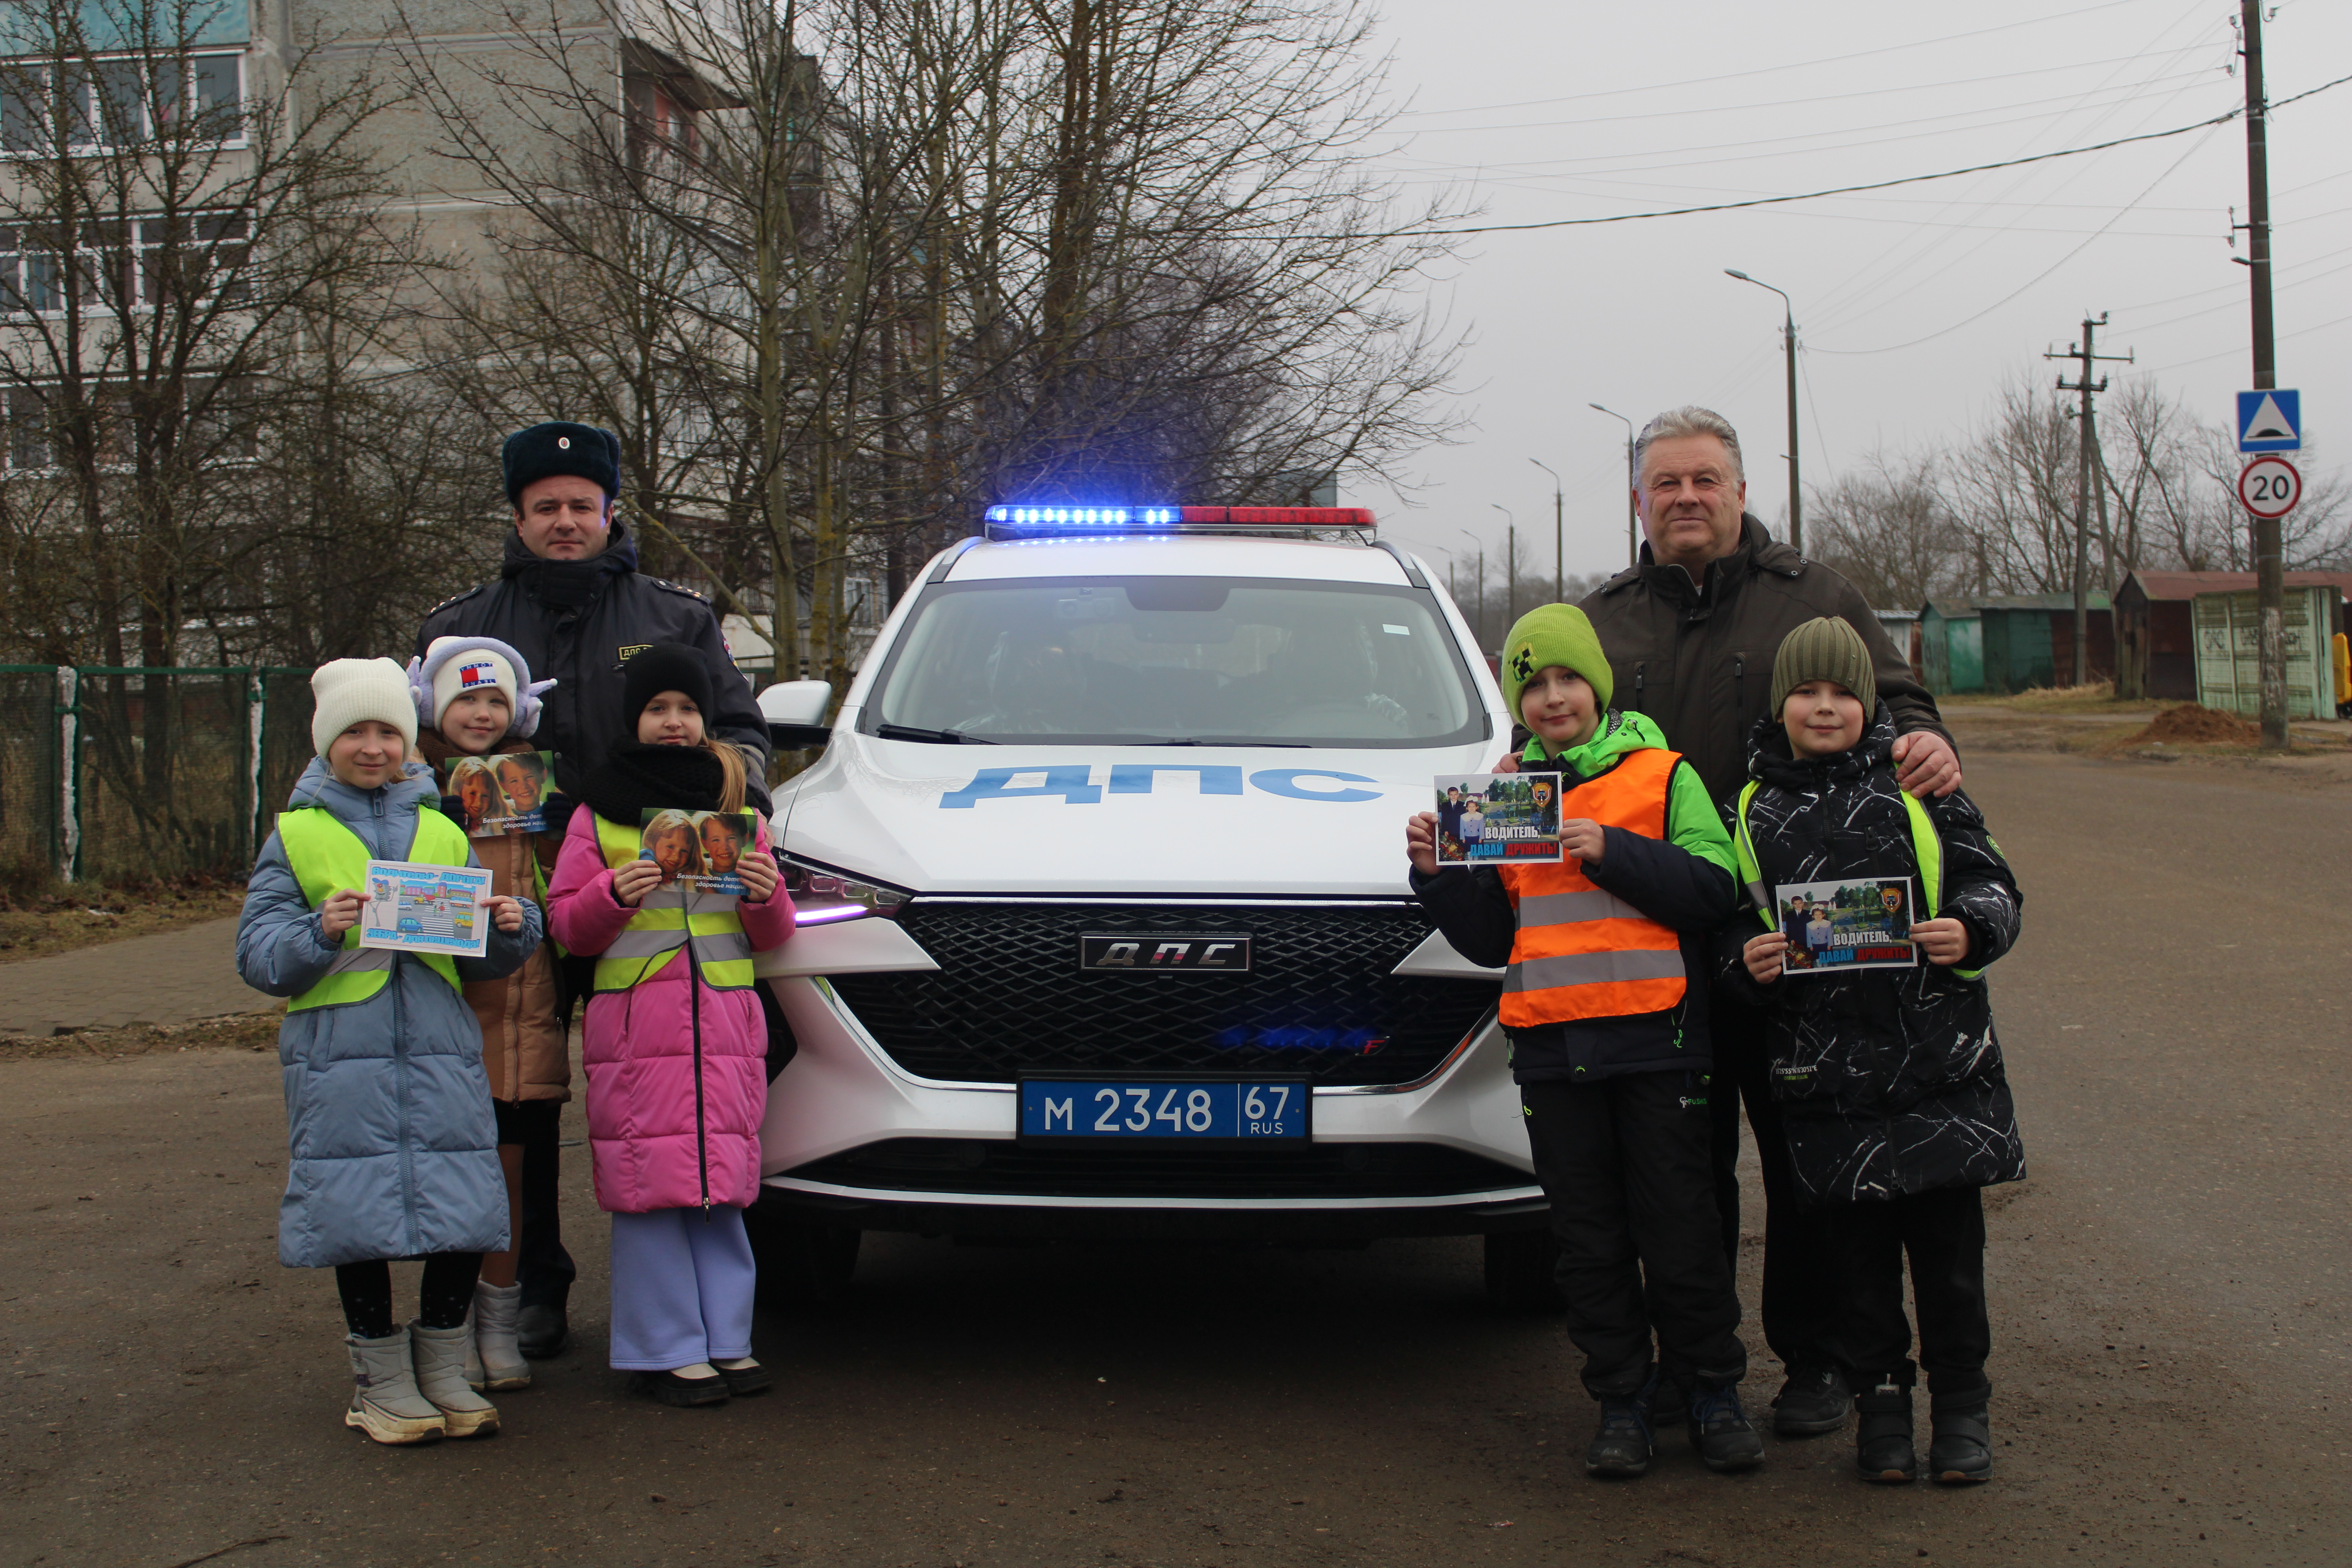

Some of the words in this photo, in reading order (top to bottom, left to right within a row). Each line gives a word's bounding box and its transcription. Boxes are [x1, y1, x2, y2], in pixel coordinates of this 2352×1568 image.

[2252, 474, 2289, 501] 20
[938, 764, 1385, 809] ДПС
[1485, 826, 1540, 840] ВОДИТЕЛЬ,
[1470, 842, 1503, 857] ДАВАЙ
[1505, 842, 1557, 857] ДРУЖИТЬ!
[439, 872, 486, 885] ДОРОГА!
[1833, 931, 1892, 946] ВОДИТЕЛЬ,
[1096, 943, 1236, 966] ДПС
[1818, 947, 1853, 965] ДАВАЙ
[1857, 947, 1911, 962] ДРУЖИТЬ!
[1045, 1097, 1073, 1130] М
[1094, 1089, 1212, 1131] 2348
[1245, 1087, 1289, 1120] 67
[1250, 1123, 1283, 1134] RUS
